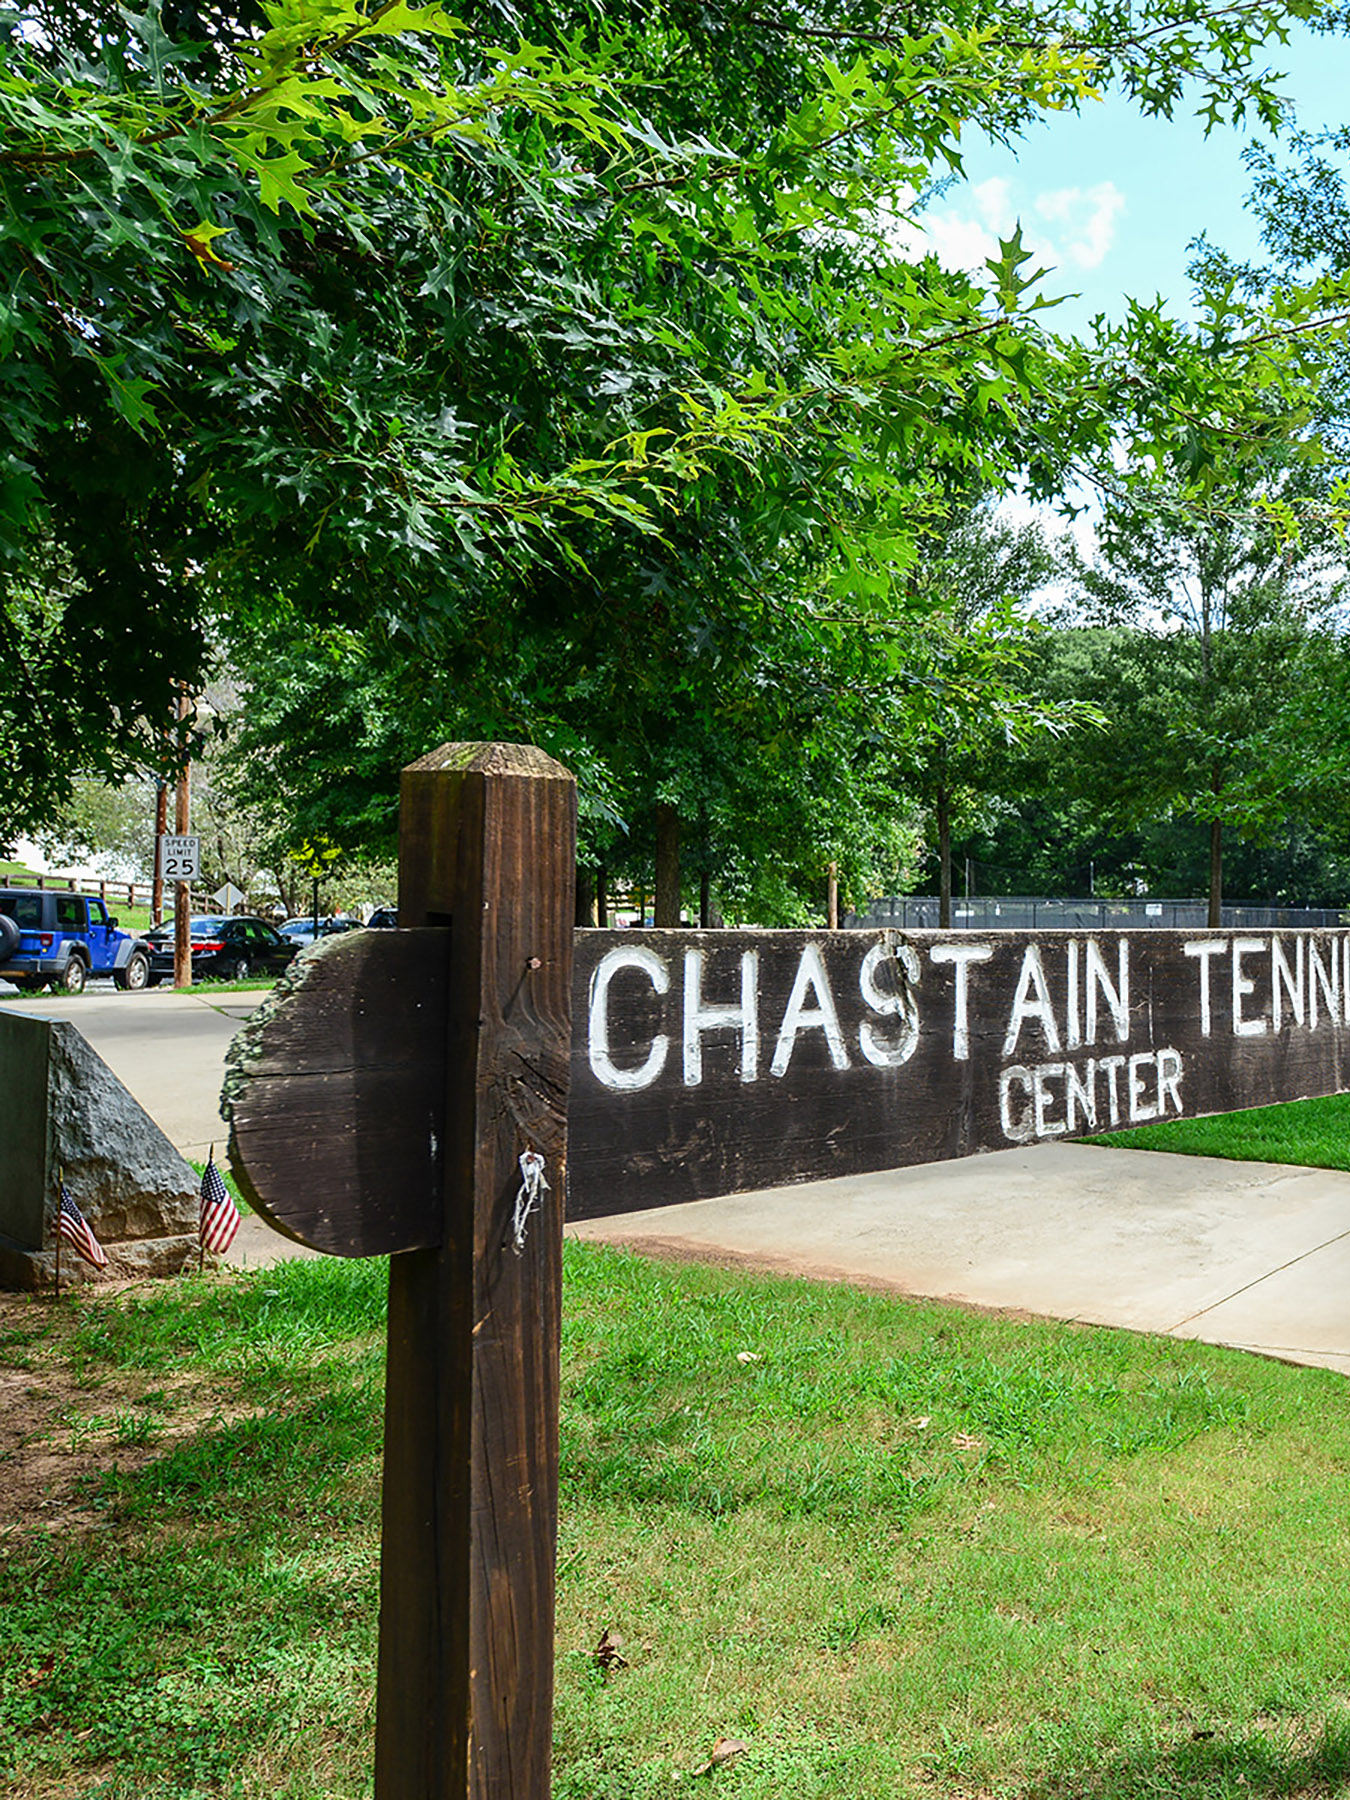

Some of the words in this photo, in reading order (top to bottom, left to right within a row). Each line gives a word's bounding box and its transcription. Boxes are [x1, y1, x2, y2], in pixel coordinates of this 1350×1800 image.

[165, 839, 196, 847] SPEED
[168, 848, 192, 856] LIMIT
[165, 858, 194, 875] 25
[588, 931, 1130, 1091] CHASTAIN
[999, 1047, 1184, 1142] CENTER
